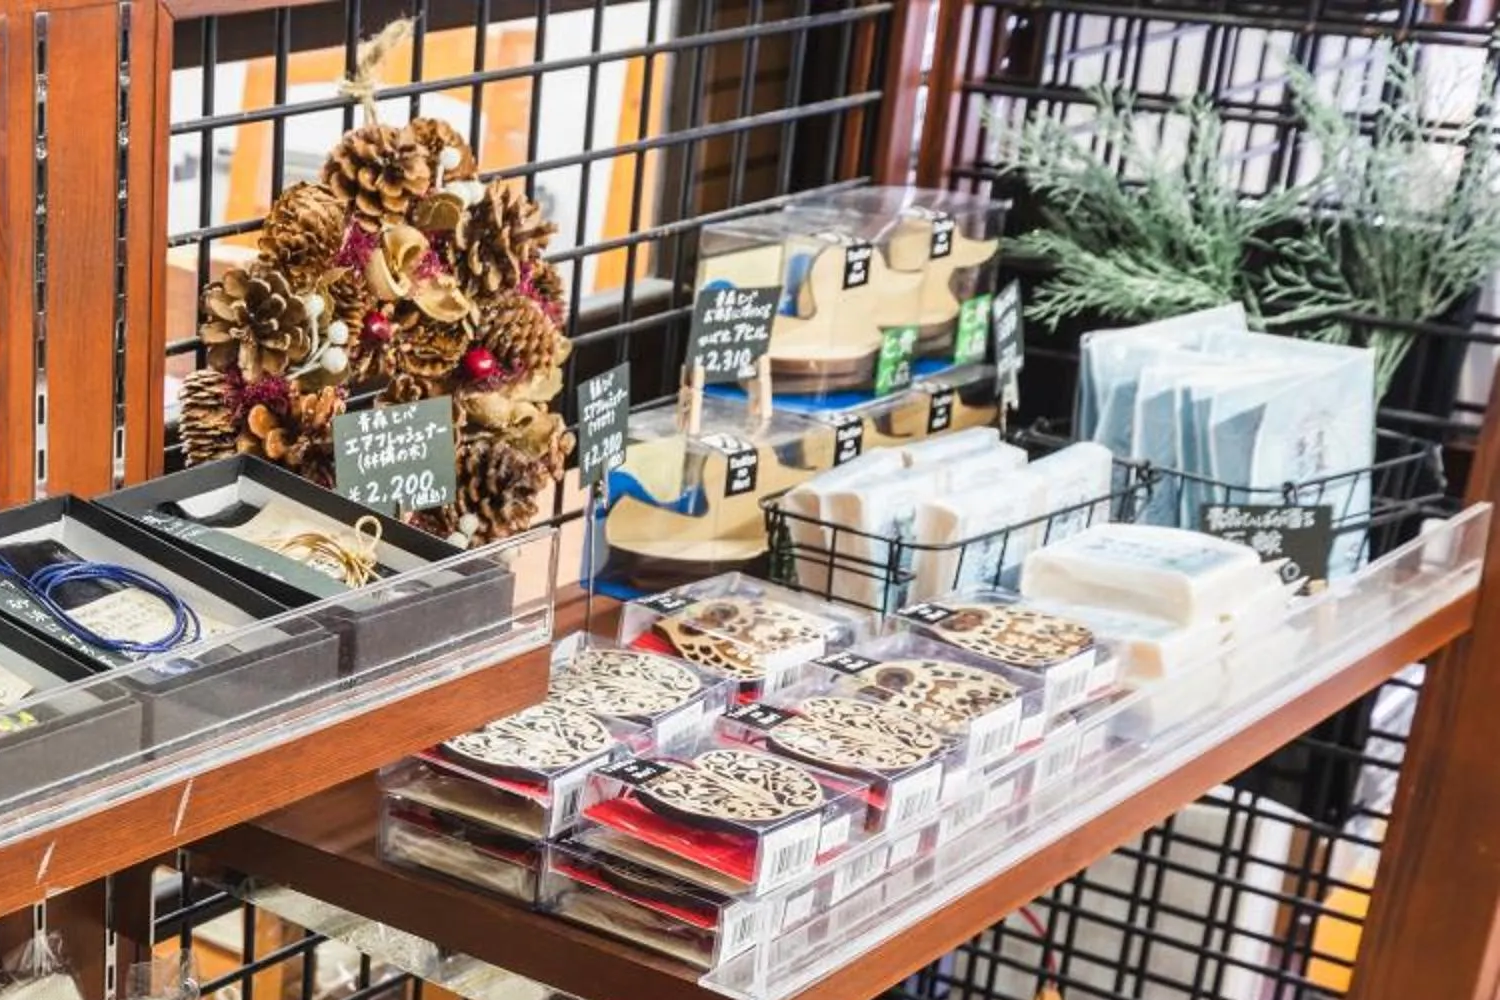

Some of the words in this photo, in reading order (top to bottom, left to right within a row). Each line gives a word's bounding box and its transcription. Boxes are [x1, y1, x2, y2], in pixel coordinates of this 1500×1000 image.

[357, 405, 417, 432] 青森ヒバ
[344, 422, 449, 455] エアフレッシュナー
